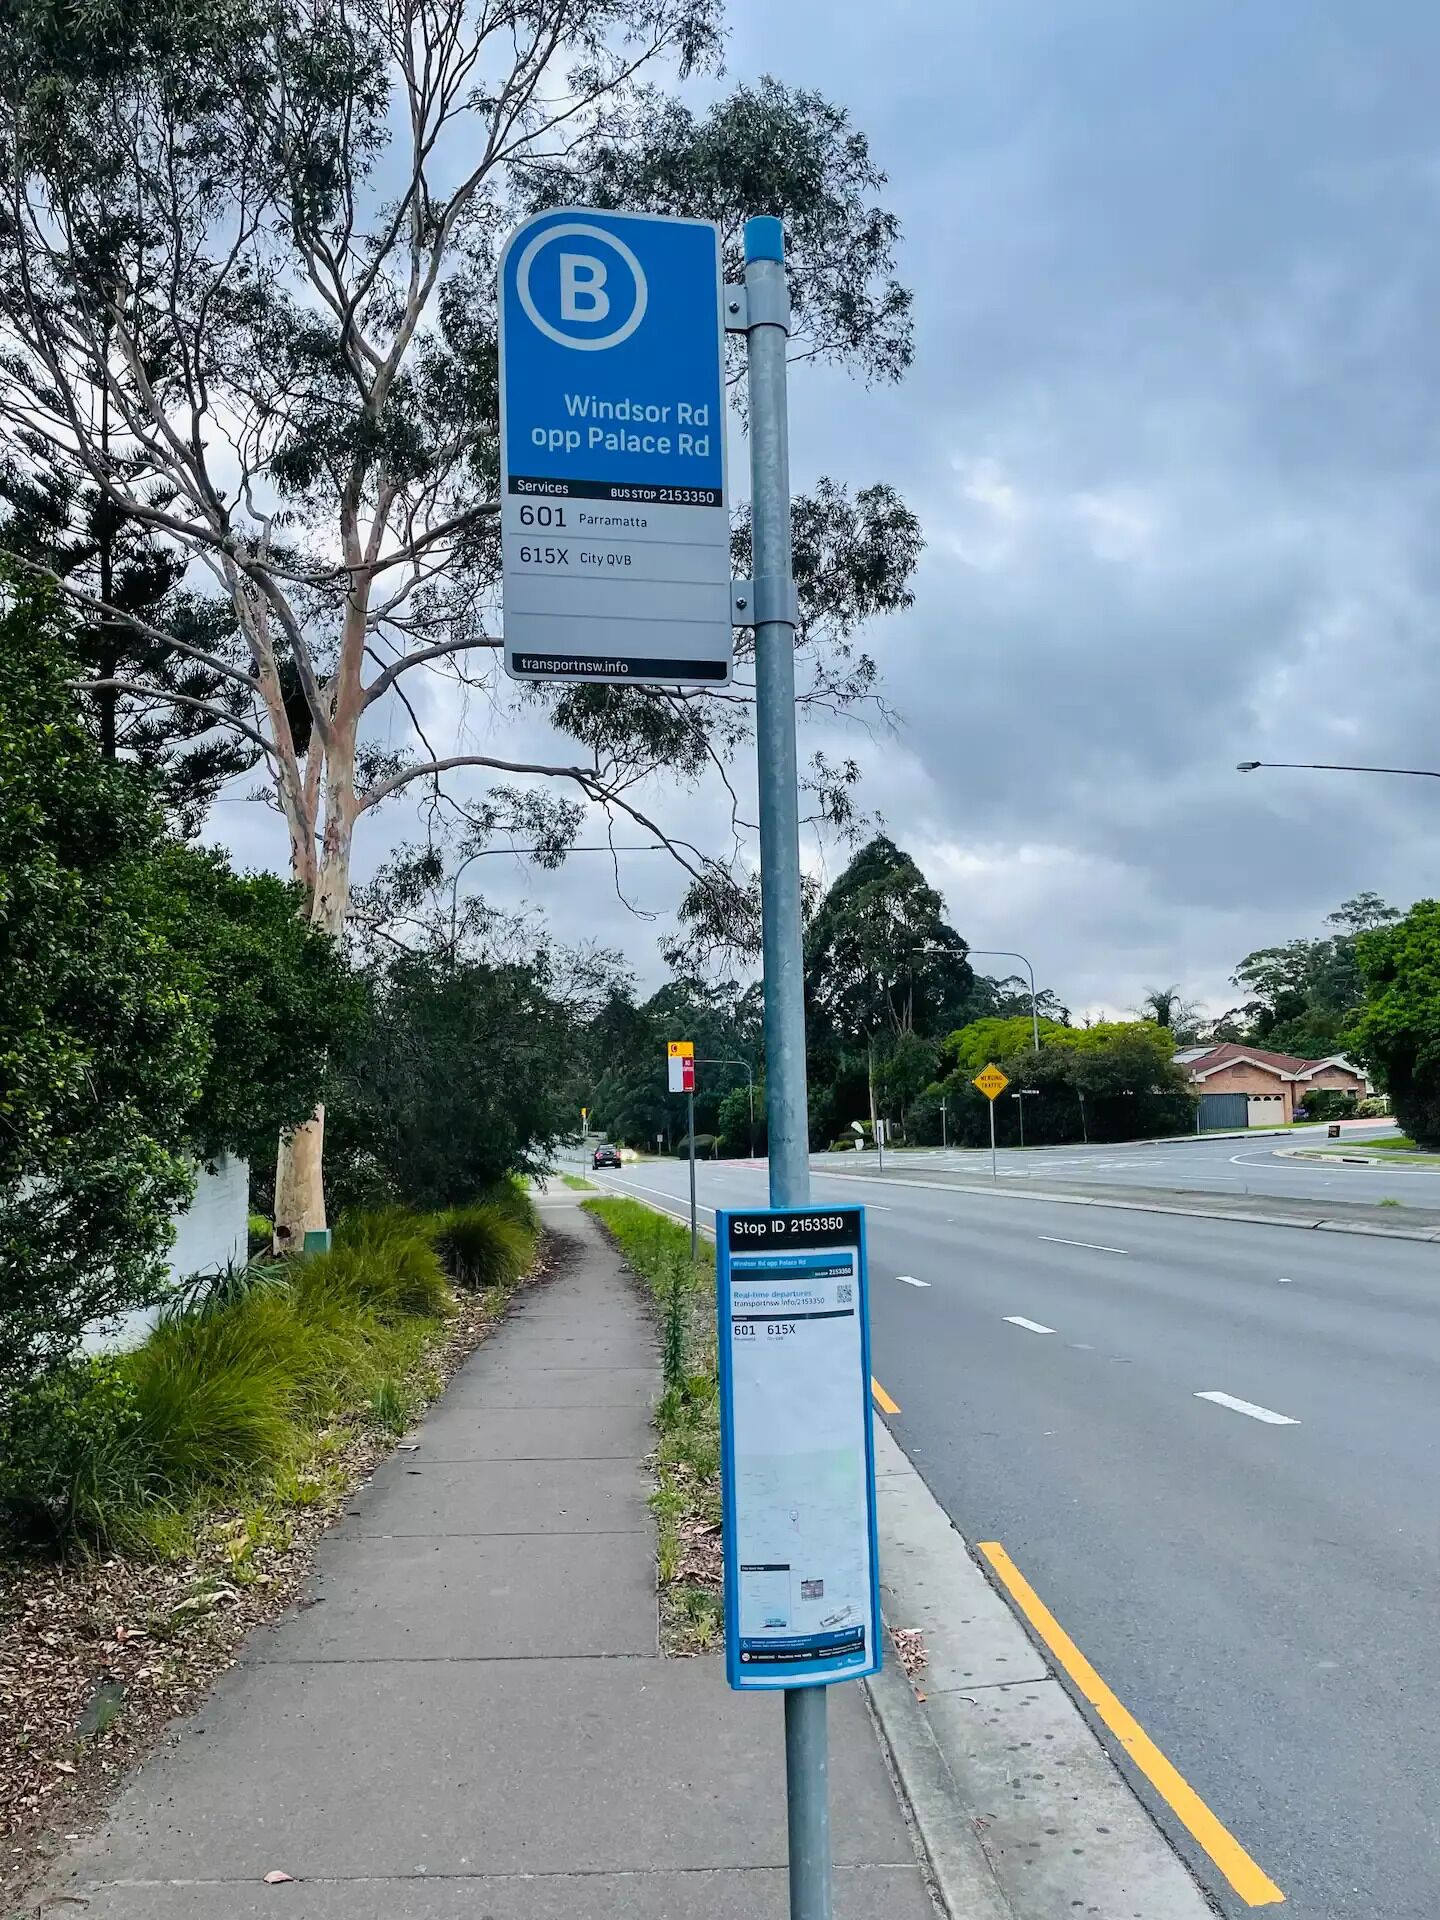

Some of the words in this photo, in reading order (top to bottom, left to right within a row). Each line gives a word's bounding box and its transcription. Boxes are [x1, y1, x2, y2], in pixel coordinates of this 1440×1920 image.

[559, 252, 610, 323] B
[564, 393, 672, 424] Windsor
[677, 402, 709, 426] Rd
[531, 427, 581, 453] opp
[588, 426, 671, 455] Palace
[678, 434, 710, 457] Rd
[517, 479, 569, 495] Services
[610, 487, 631, 498] BUS
[631, 489, 657, 500] STOP
[659, 489, 715, 504] 2153350
[519, 505, 567, 528] 601
[578, 513, 648, 528] Parramatta
[520, 546, 569, 565] 615X
[580, 552, 604, 567] City
[606, 553, 632, 566] QVB
[521, 657, 629, 674] transportnsw.info
[733, 1221, 767, 1236] Stop
[771, 1220, 786, 1233] ID
[790, 1216, 843, 1233] 2153350
[828, 1267, 852, 1276] 2153350
[733, 1291, 769, 1299] Real-time
[771, 1290, 812, 1299] departures
[734, 1297, 825, 1308] transportnswinfo/2153350
[734, 1325, 756, 1336] 601
[767, 1324, 796, 1335] 615X
